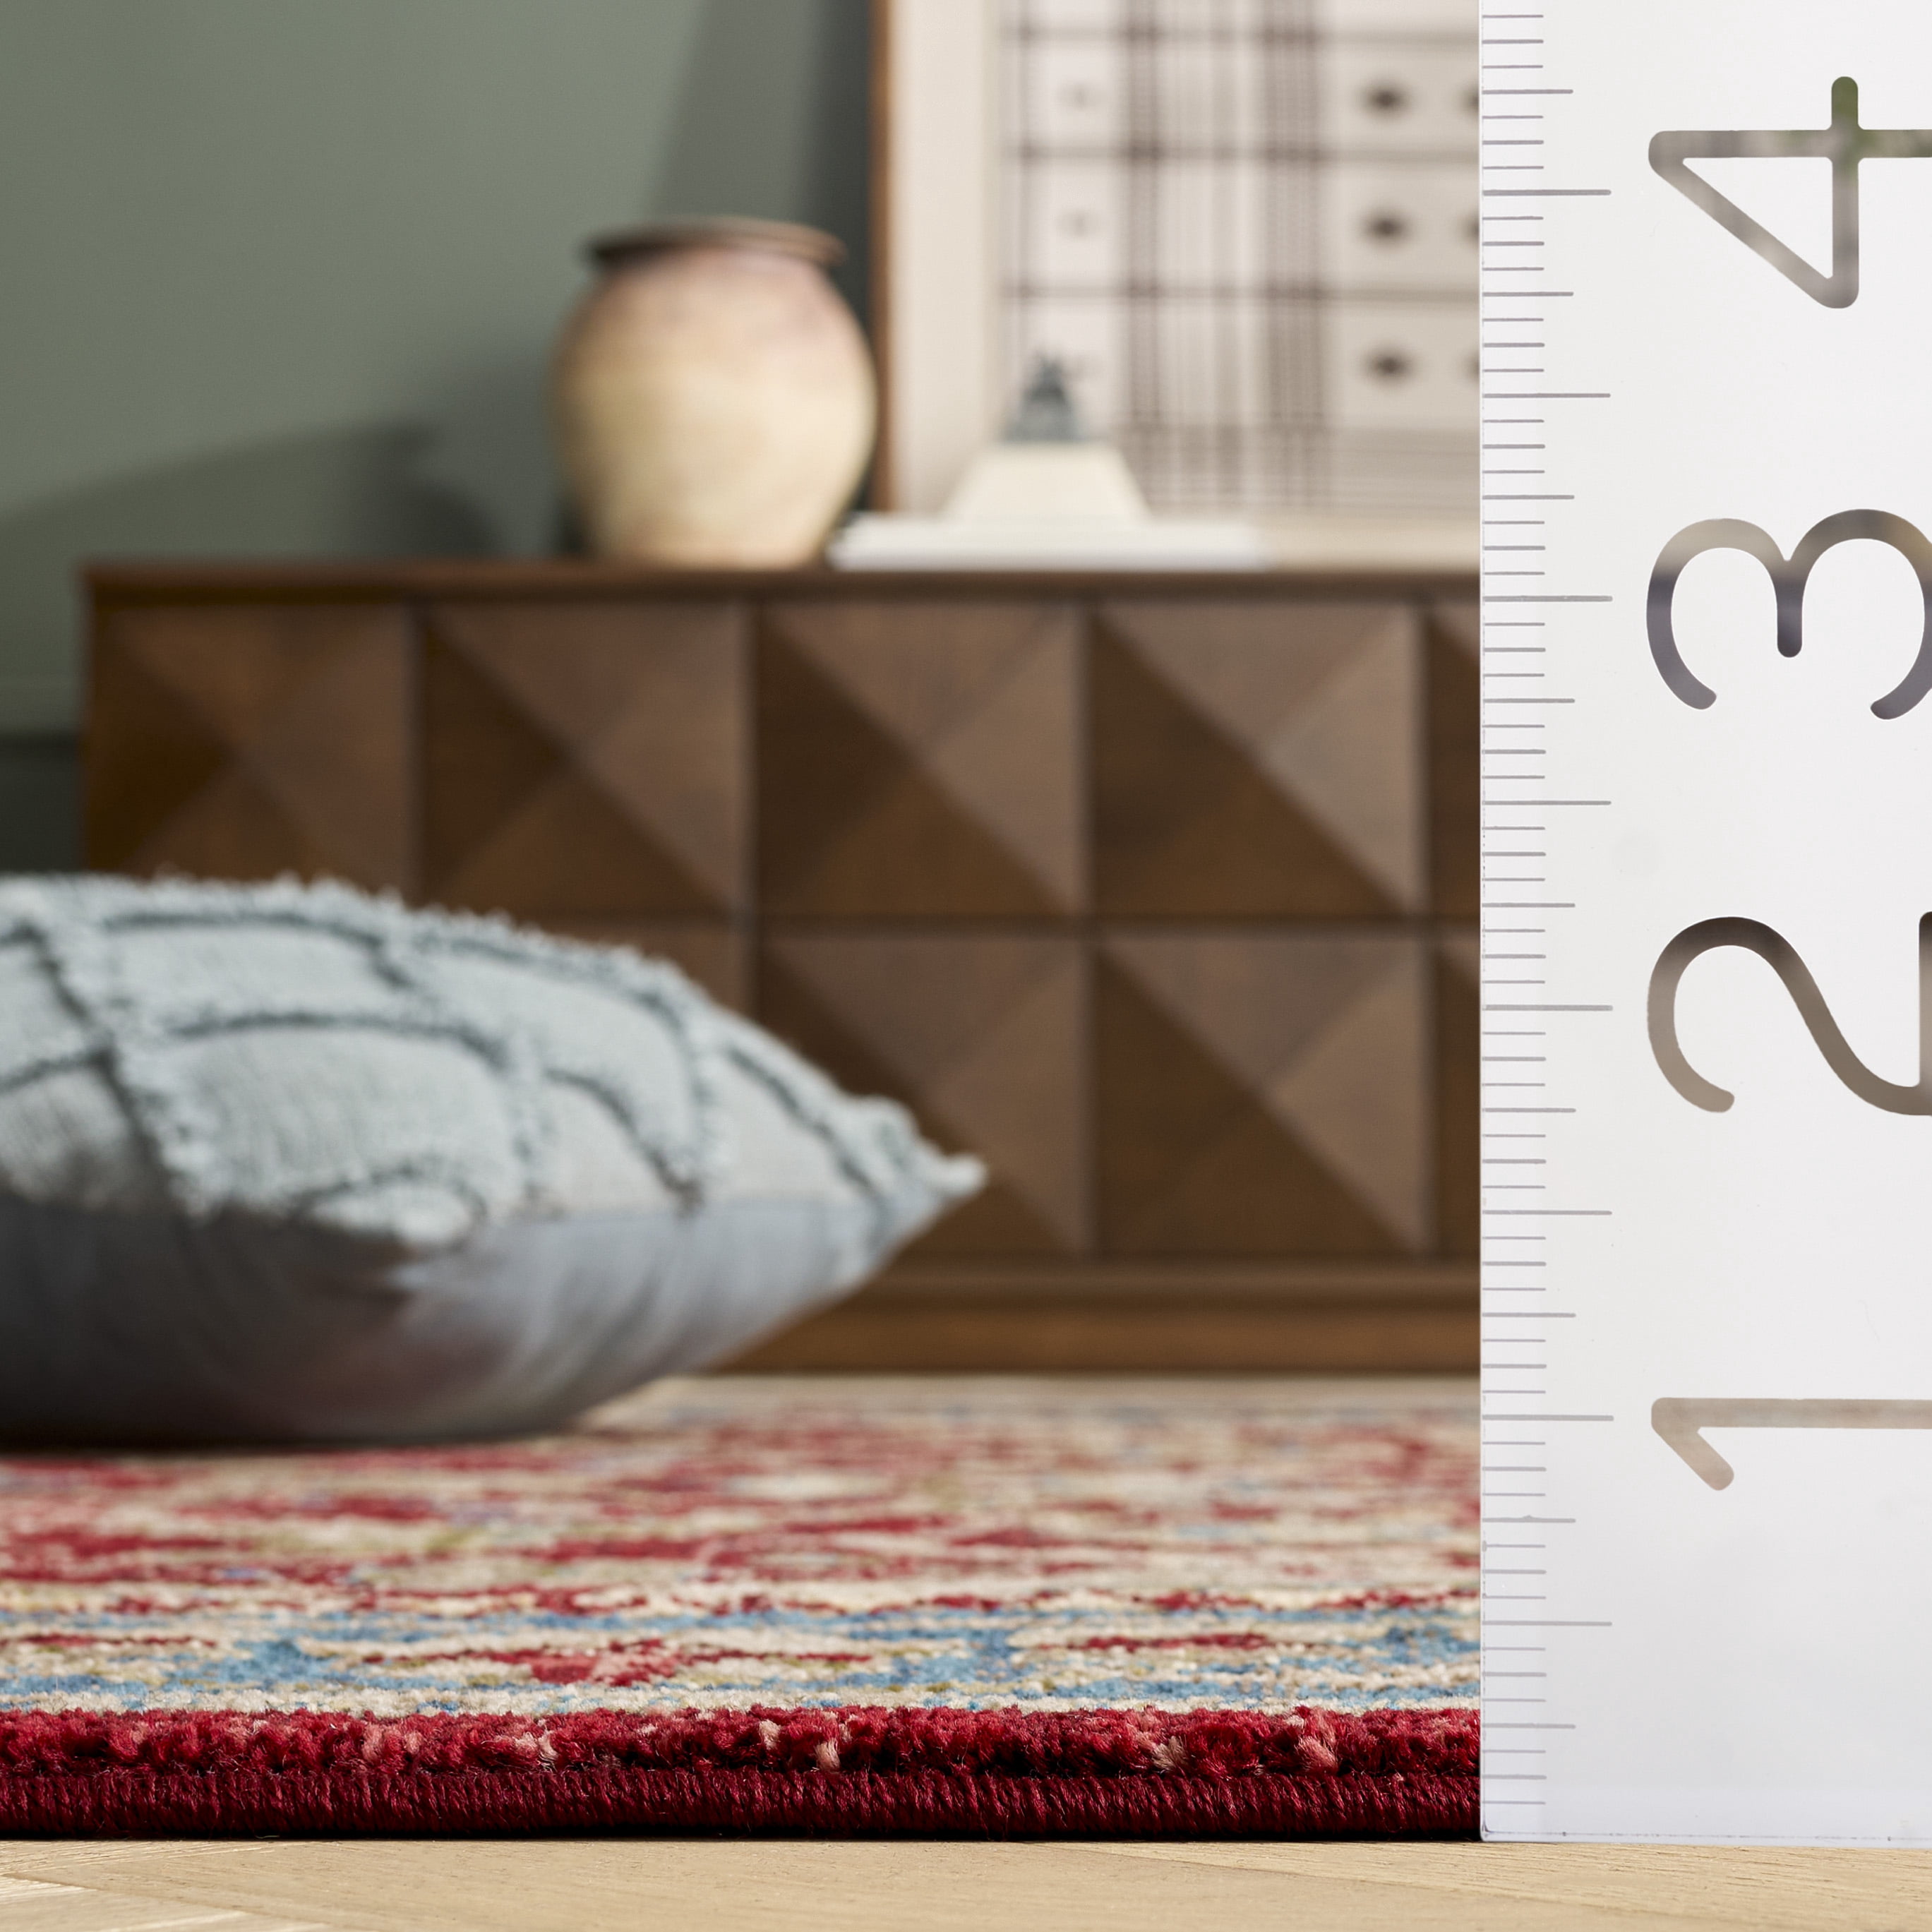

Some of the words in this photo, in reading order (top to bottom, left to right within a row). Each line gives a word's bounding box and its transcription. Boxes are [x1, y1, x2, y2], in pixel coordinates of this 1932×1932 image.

[1648, 76, 1932, 308] 4
[1646, 508, 1932, 720] 3
[1647, 911, 1932, 1116] 2
[1651, 1397, 1932, 1491] 1
